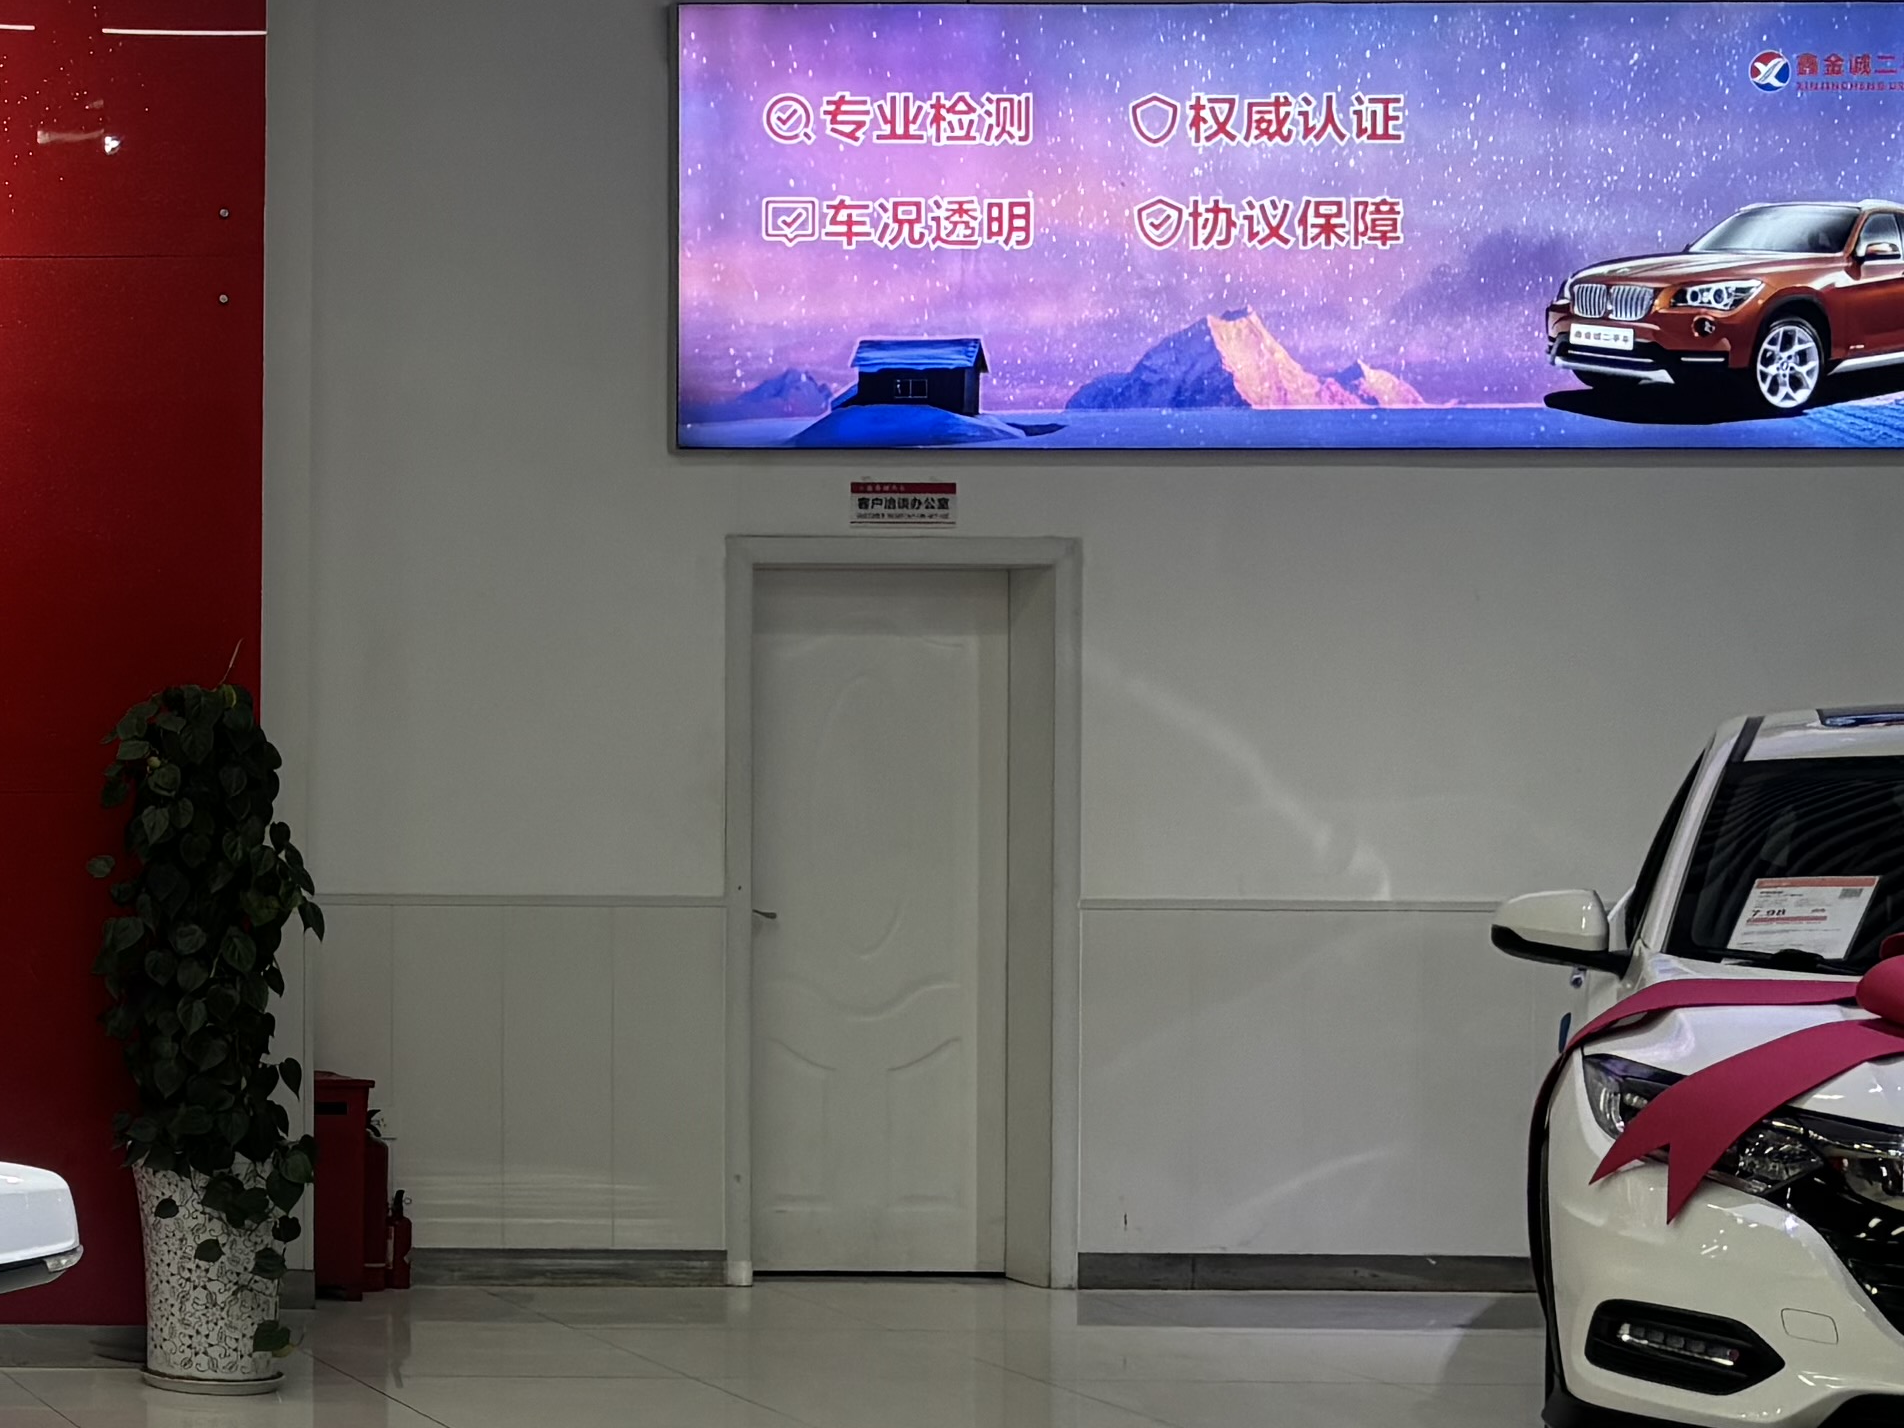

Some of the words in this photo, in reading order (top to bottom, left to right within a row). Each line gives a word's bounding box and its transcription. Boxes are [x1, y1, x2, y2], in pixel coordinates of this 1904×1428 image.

[1796, 52, 1904, 76] 鑫金诚二
[821, 92, 1035, 146] 专业检测
[1188, 92, 1405, 146] 权威认证
[821, 196, 1035, 250] 车况透明
[1188, 196, 1405, 250] 协议保障
